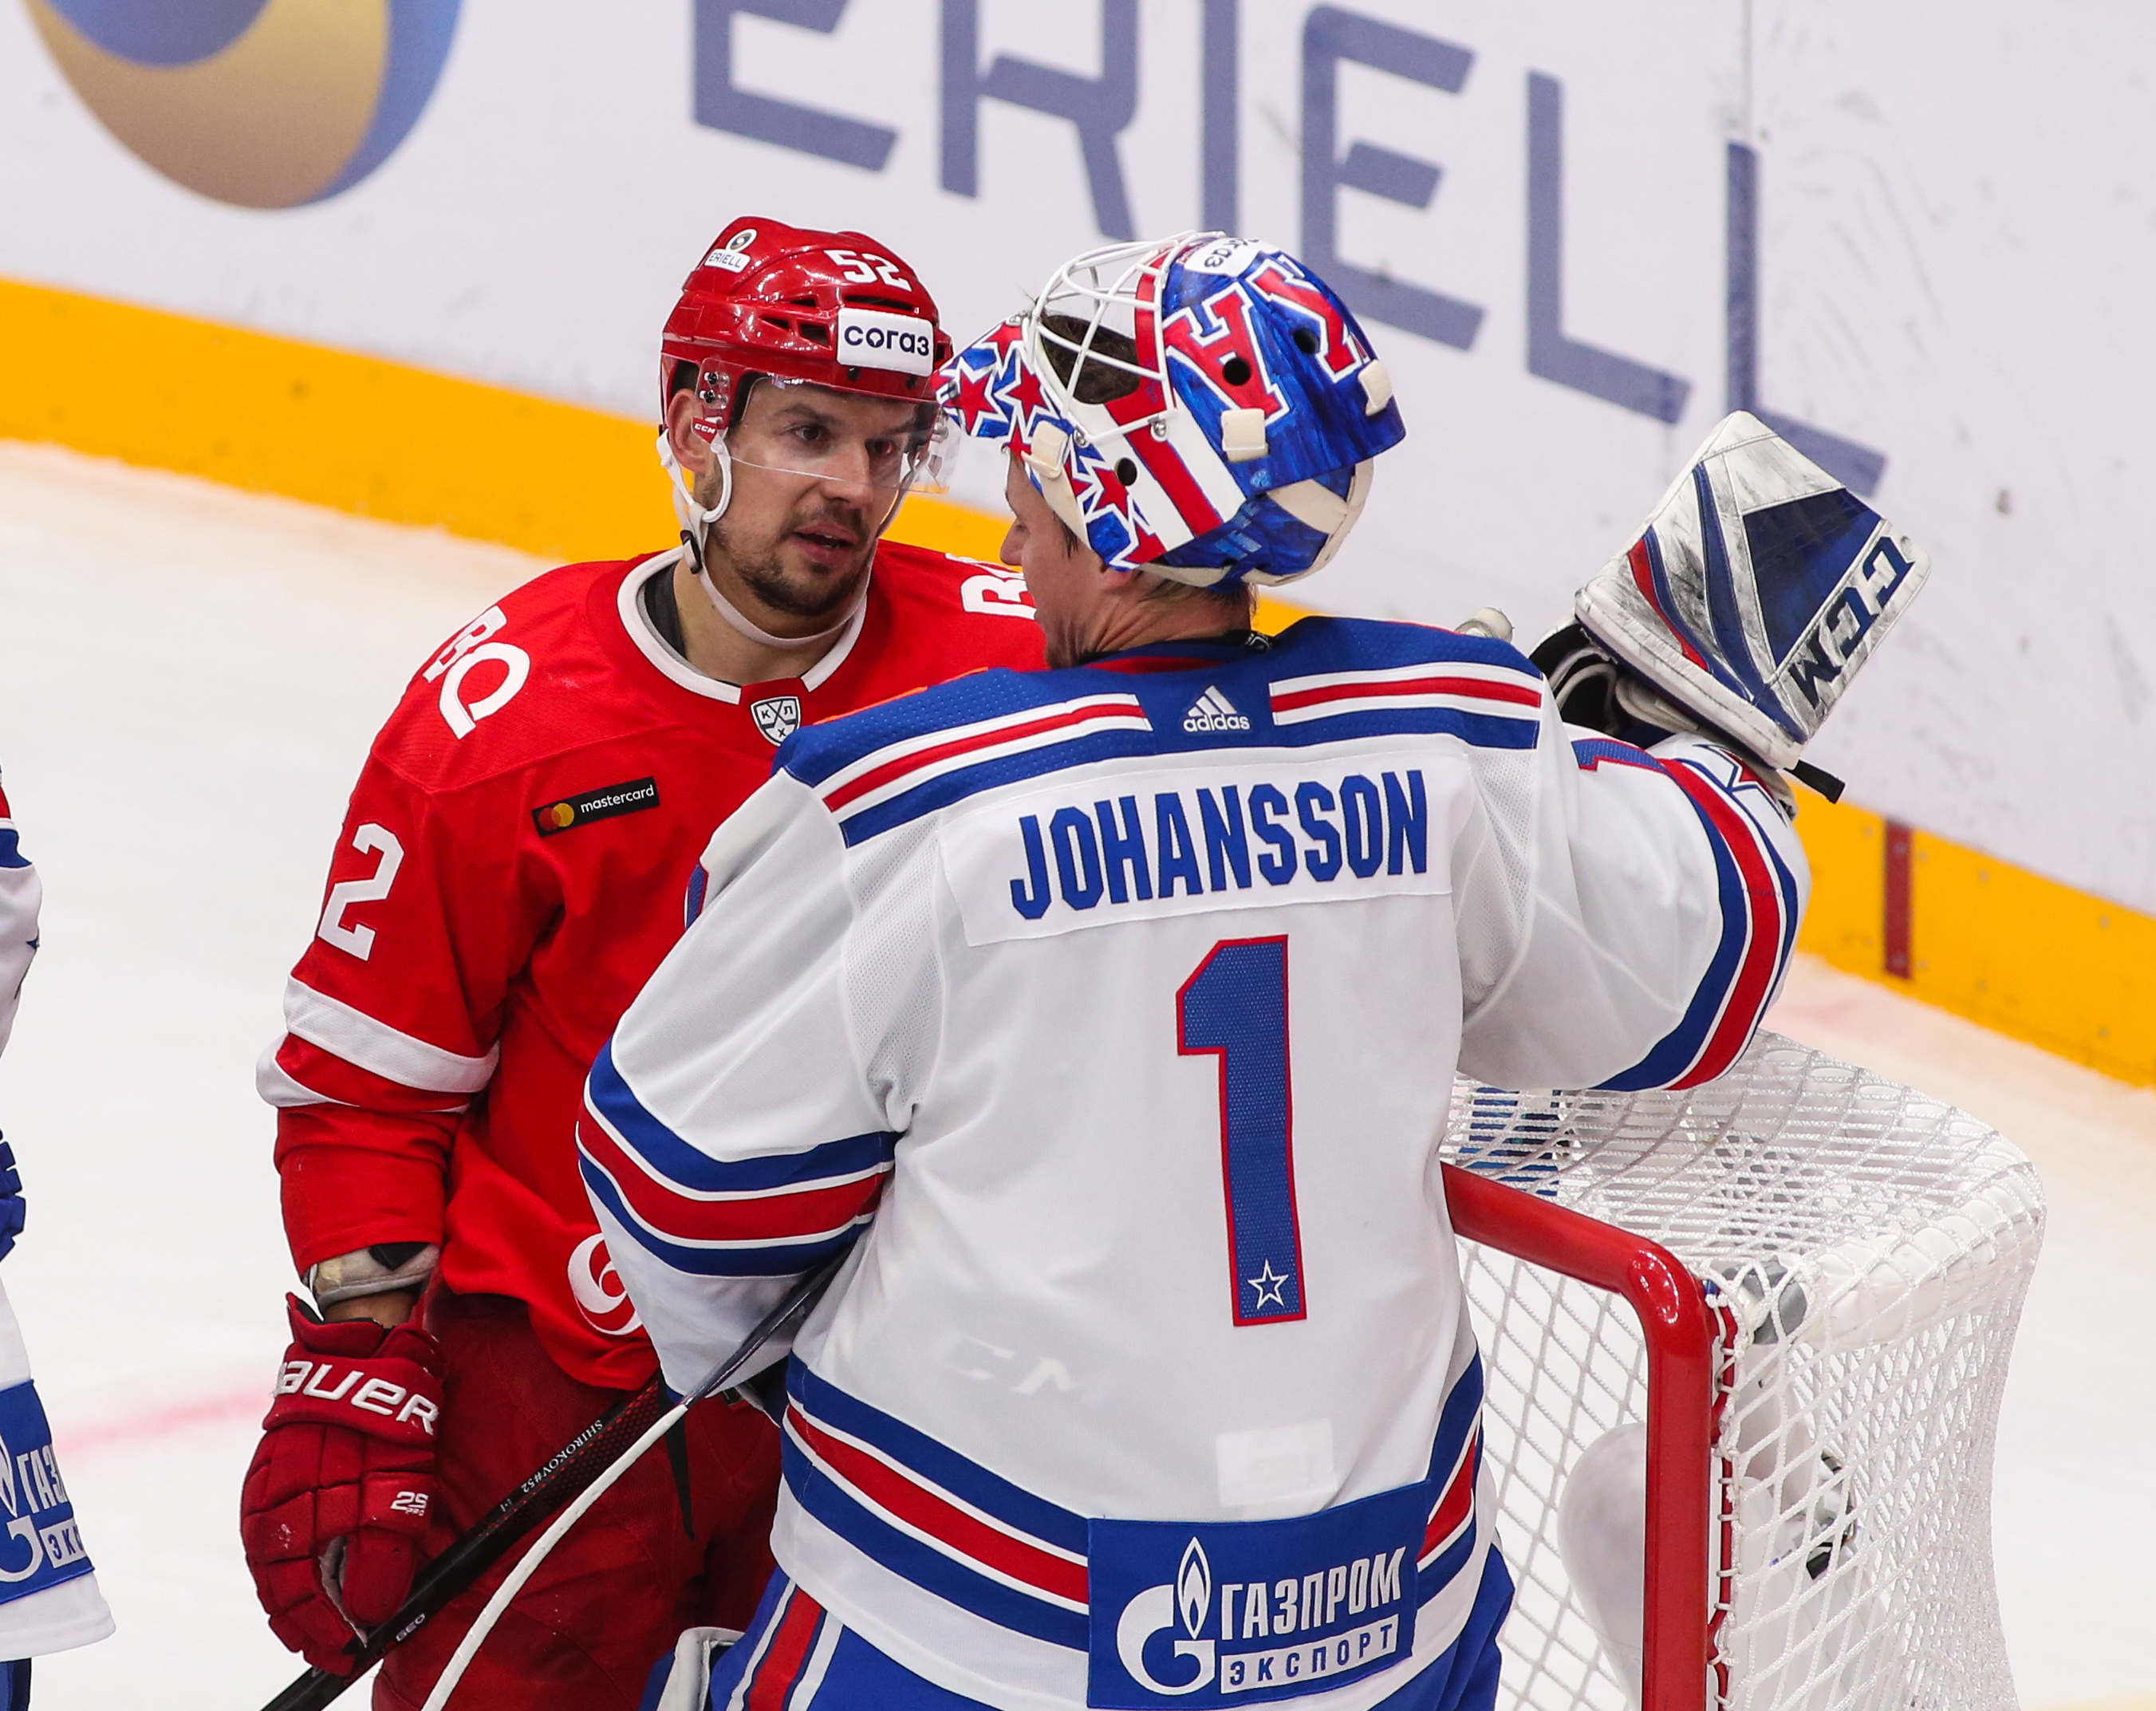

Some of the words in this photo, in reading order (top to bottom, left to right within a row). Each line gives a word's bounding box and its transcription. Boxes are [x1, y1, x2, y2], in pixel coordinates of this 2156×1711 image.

[708, 252, 742, 268] ERIELL
[824, 249, 912, 292] 52
[844, 325, 930, 357] согаз
[694, 421, 716, 435] CCM
[1788, 535, 1916, 708] CCM
[1183, 711, 1251, 732] adidas
[580, 784, 655, 814] mastercard
[1009, 769, 1428, 921] JOHANSSON
[317, 822, 405, 962] 2
[1176, 934, 1307, 1327] 1
[521, 1419, 603, 1494] SHIROKOV#52
[1221, 1547, 1407, 1640] ГАЗПРОМ
[1229, 1622, 1393, 1685] ЭКСПОРТ
